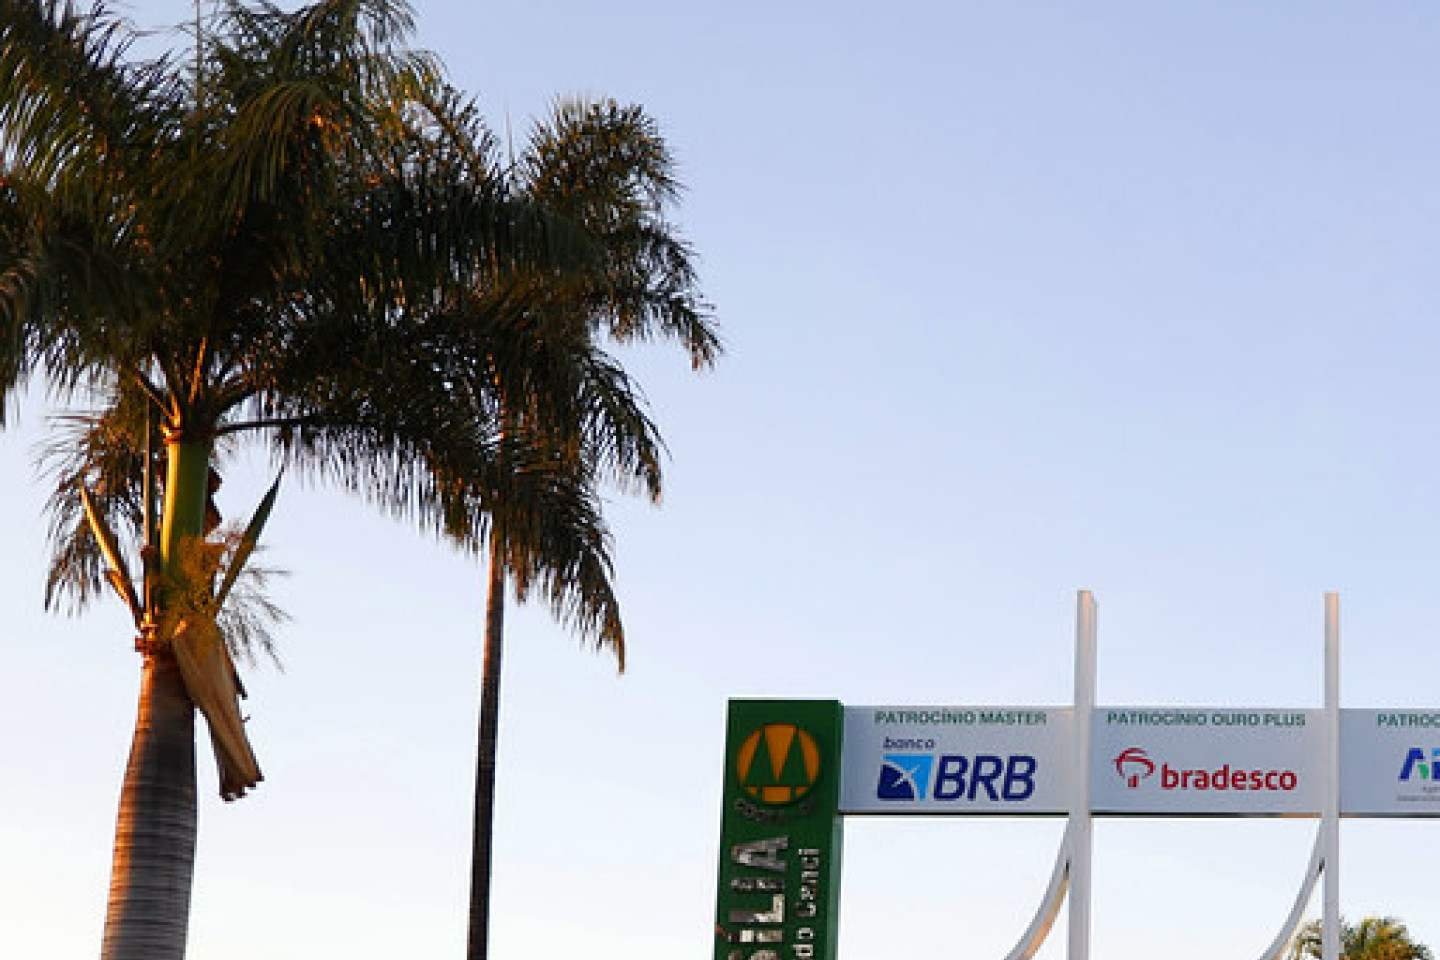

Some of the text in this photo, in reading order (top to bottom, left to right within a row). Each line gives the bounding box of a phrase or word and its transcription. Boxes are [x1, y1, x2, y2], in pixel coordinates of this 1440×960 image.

[874, 709, 1047, 726] PATROCÍNIO MASTER
[1107, 711, 1306, 727] PATROCÍNIO OURO PLUS
[882, 736, 936, 750] banco
[933, 755, 1038, 801] BRB
[1160, 762, 1298, 791] bradesco
